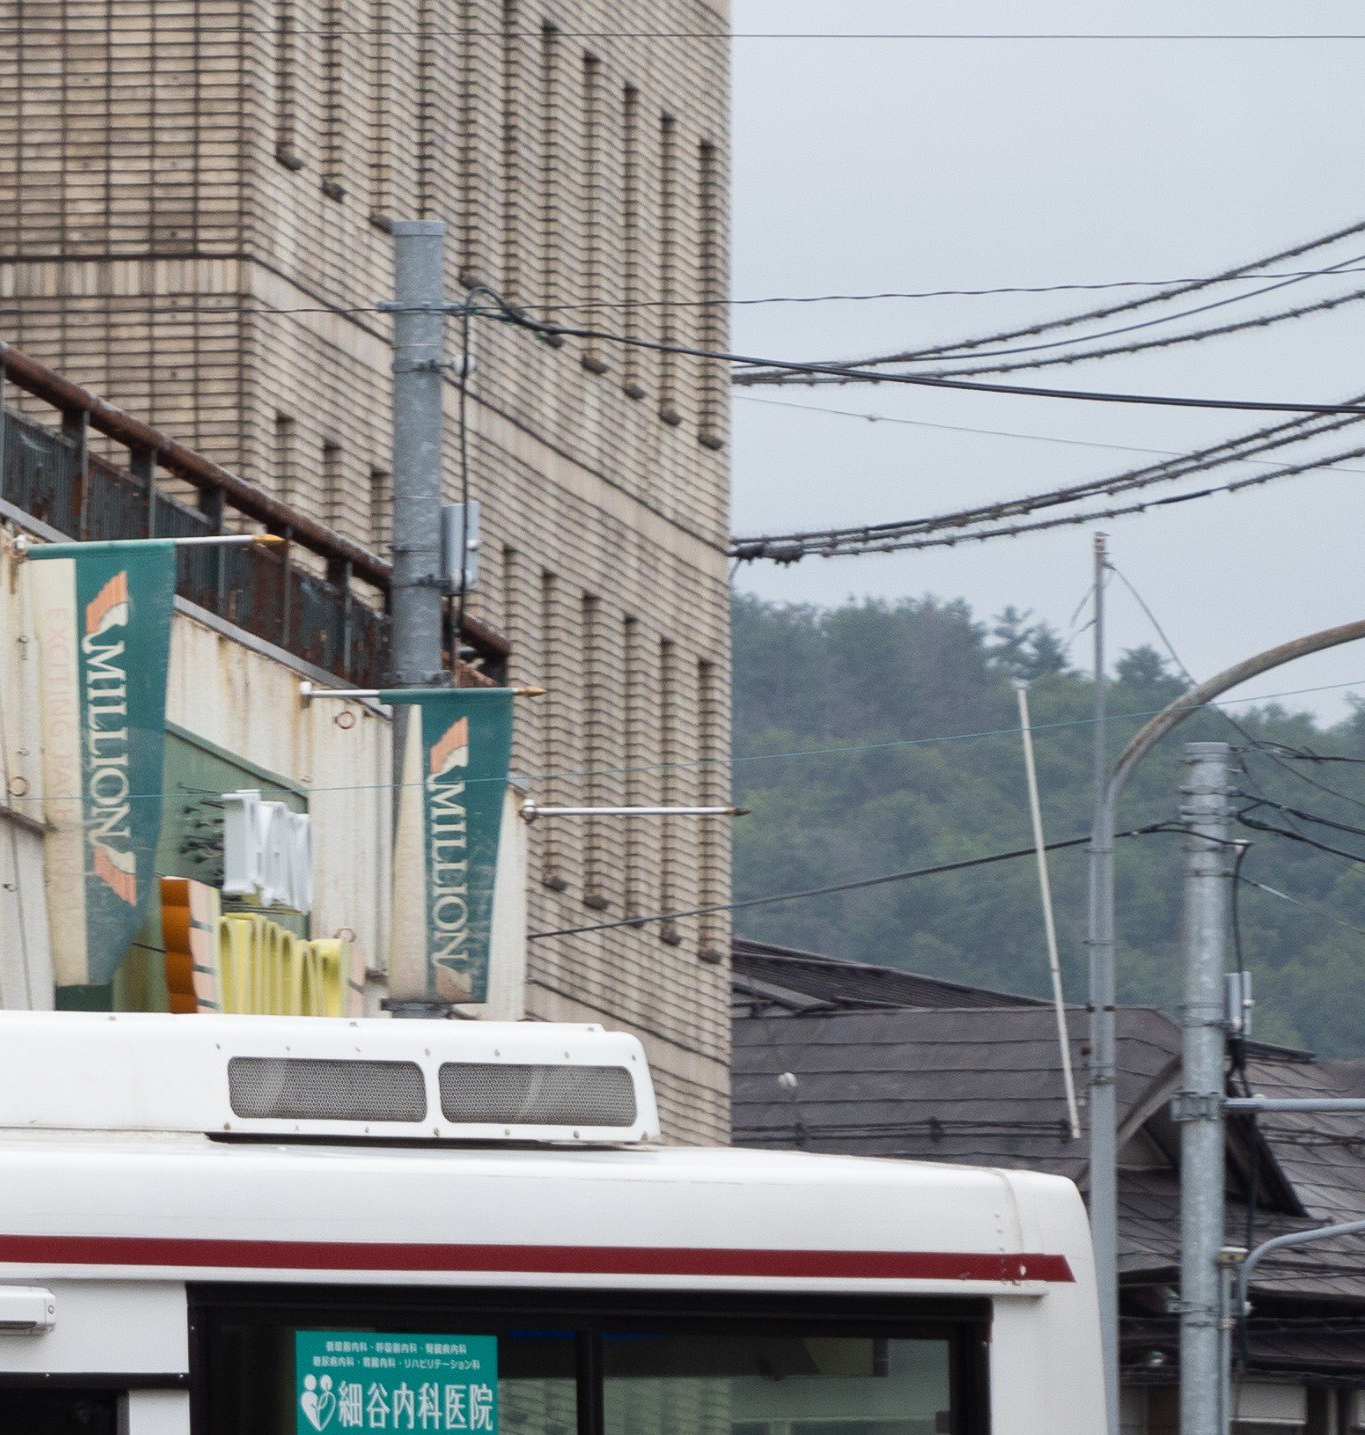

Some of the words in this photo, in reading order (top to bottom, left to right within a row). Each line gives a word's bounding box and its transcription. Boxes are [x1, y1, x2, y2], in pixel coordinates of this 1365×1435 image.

[81, 633, 133, 852] MILLION
[426, 772, 470, 969] MILLION
[338, 1379, 495, 1432] 細谷内科医院
